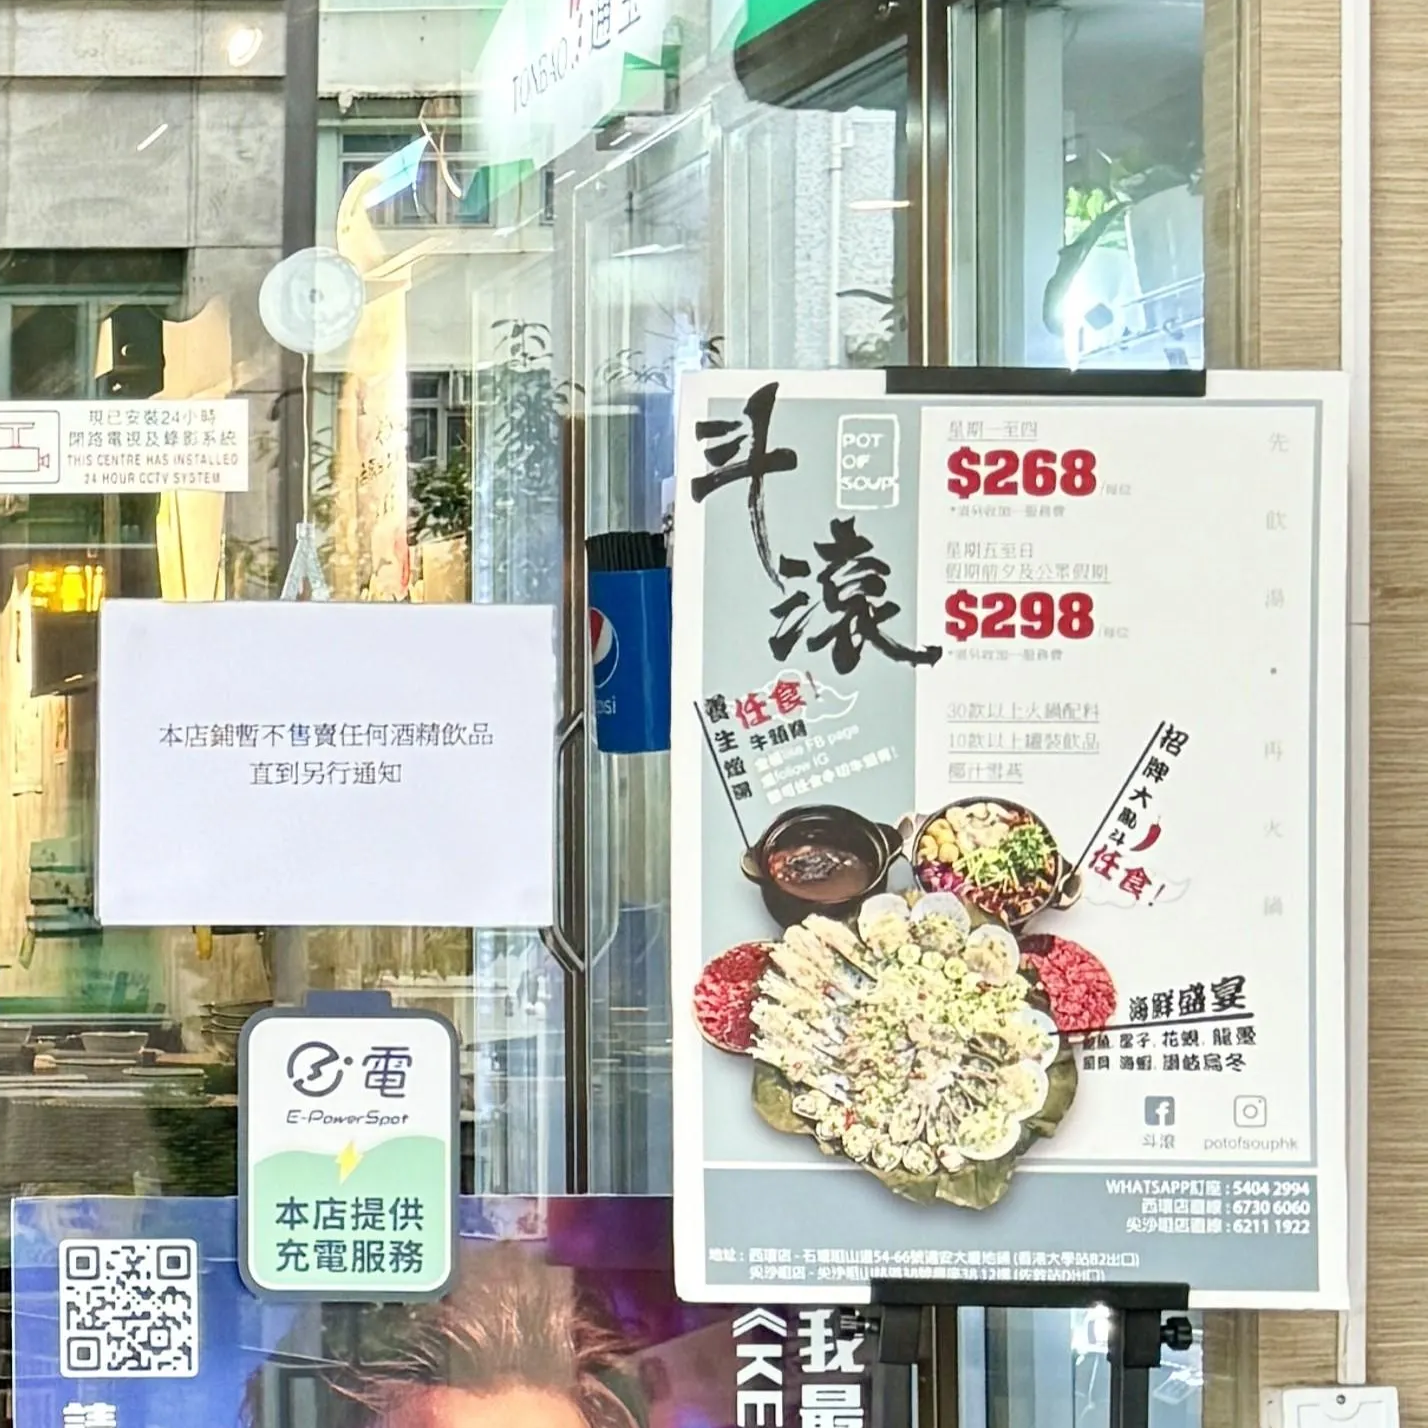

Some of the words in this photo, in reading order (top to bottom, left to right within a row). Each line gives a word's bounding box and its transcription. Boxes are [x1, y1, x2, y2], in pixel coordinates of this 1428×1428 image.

[842, 432, 884, 448] POT
[67, 453, 93, 467] THIS
[97, 454, 141, 467] CENTRE
[145, 454, 169, 467] HAS
[172, 454, 239, 468] INSTALLED
[842, 454, 870, 470] OF
[101, 472, 135, 485] HOUR
[139, 472, 169, 485] CCTV
[172, 472, 221, 485] SYSTEM
[946, 446, 1098, 500] $268
[944, 588, 1095, 642] $298
[248, 760, 403, 786] 直到另行通知
[285, 1108, 410, 1127] E-PowerSpot
[1232, 1180, 1270, 1197] 5404
[1272, 1181, 1310, 1197] 2994
[274, 1194, 425, 1232] 本店提供
[1232, 1200, 1271, 1216] 6730
[1272, 1200, 1311, 1216] 6060
[1233, 1219, 1269, 1234] 6211
[1274, 1219, 1310, 1234] 1922
[275, 1237, 424, 1275] 充電服務
